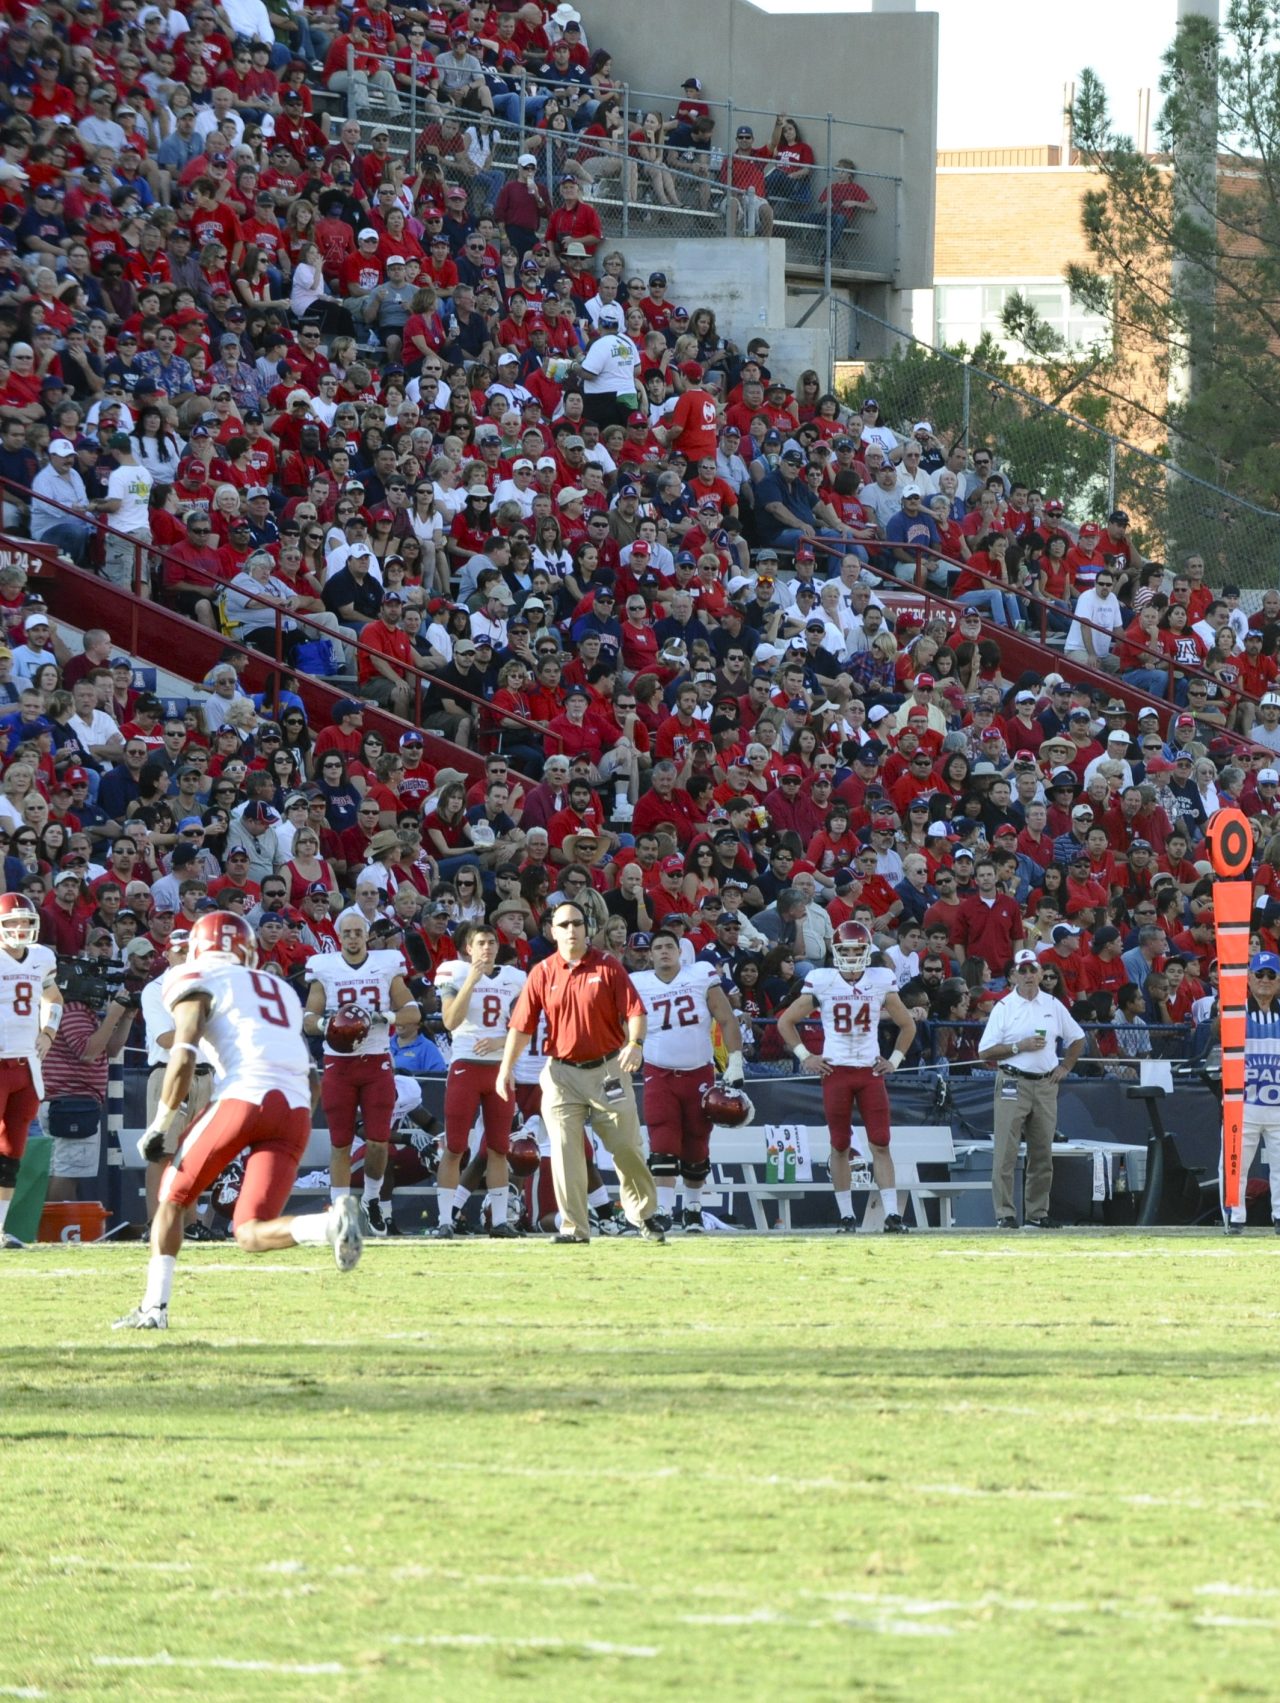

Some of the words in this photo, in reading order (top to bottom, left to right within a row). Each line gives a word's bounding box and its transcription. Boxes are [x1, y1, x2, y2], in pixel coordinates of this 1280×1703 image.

[1174, 638, 1201, 664] A
[222, 935, 232, 952] 9
[335, 979, 364, 987] WASHINGTON
[650, 990, 678, 1001] WASHINGTON
[679, 987, 693, 996] STATE
[14, 982, 32, 1015] 8
[248, 970, 290, 1028] 9
[337, 986, 381, 1012] 83
[482, 995, 501, 1027] 8
[653, 995, 699, 1031] 72
[833, 1003, 872, 1033] 84
[770, 1155, 779, 1166] G
[786, 1153, 796, 1165] G
[61, 1224, 80, 1244] G
